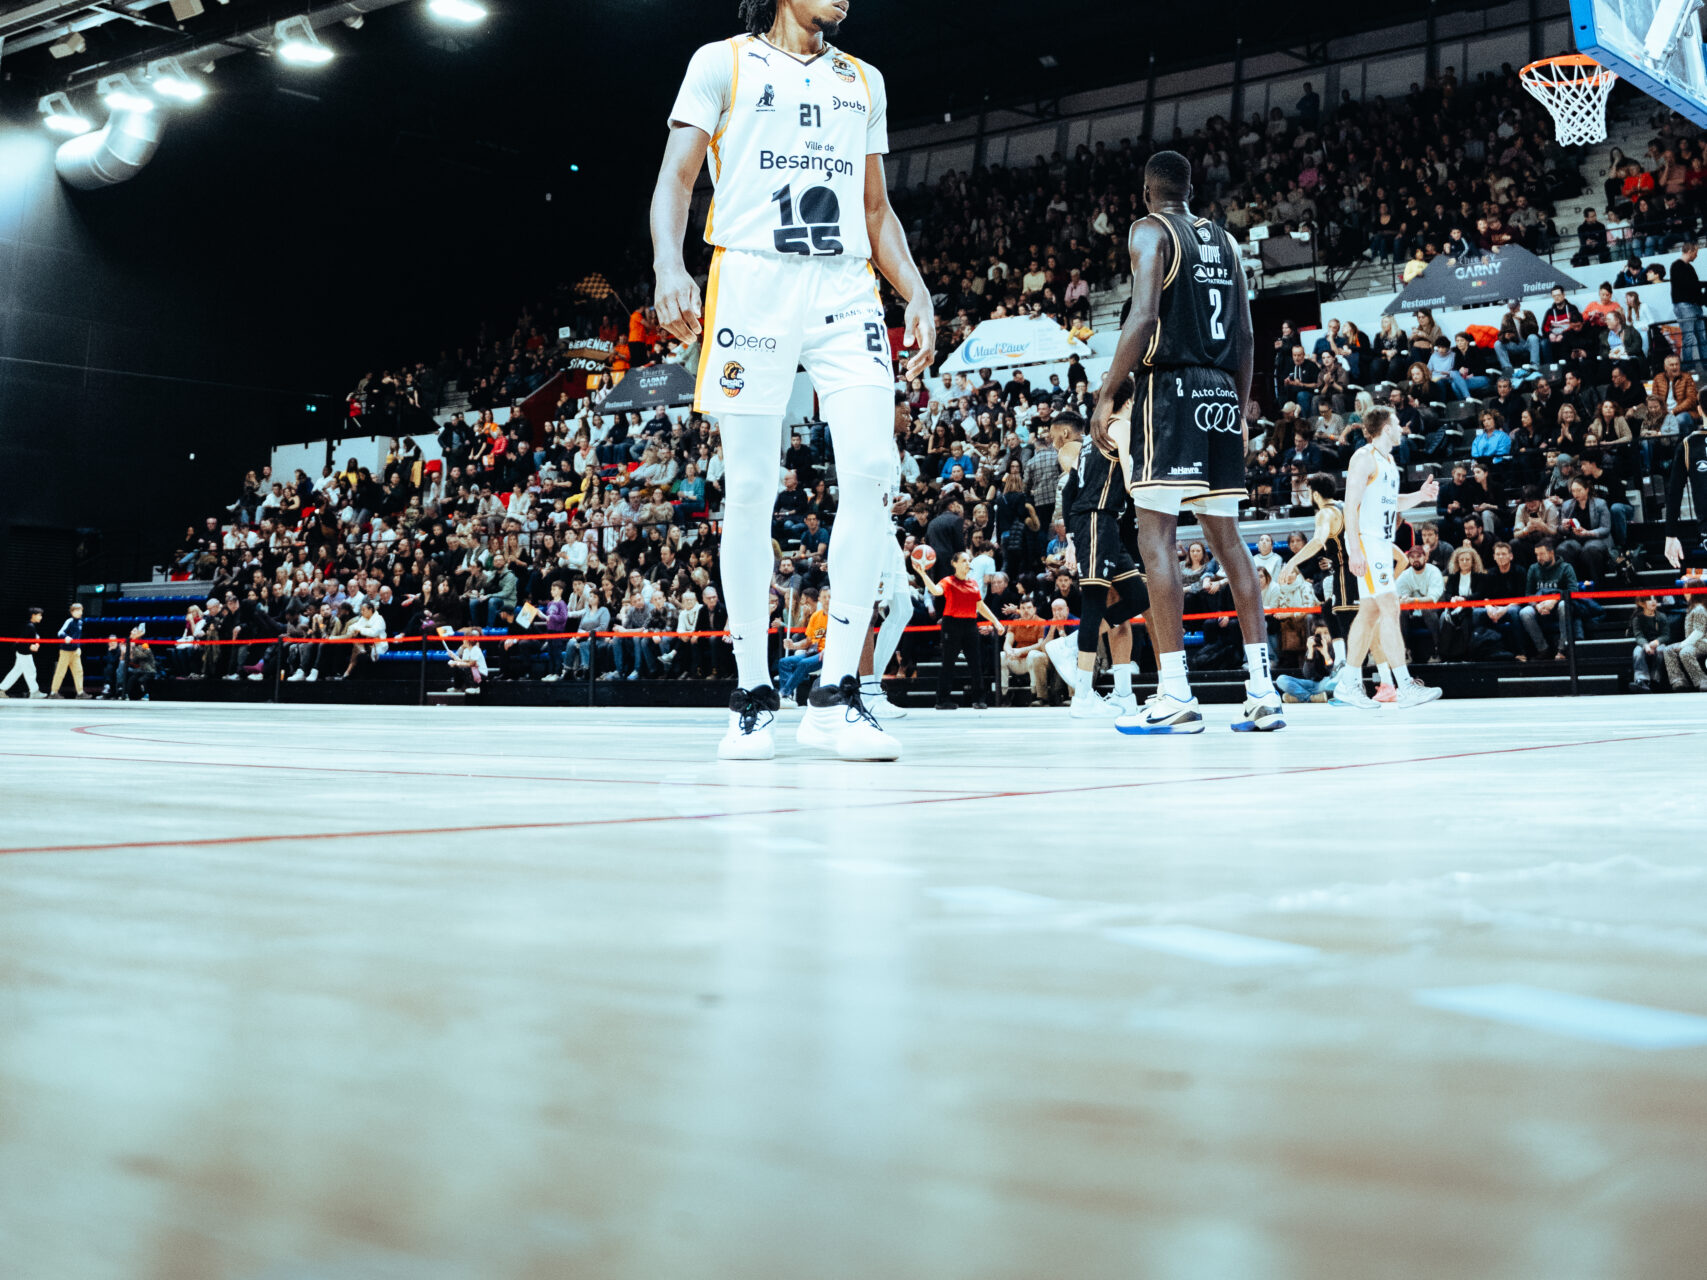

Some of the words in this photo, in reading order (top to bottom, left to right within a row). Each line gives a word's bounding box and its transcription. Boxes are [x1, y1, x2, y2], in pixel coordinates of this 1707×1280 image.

[800, 103, 821, 128] 21
[805, 141, 823, 151] Ville
[824, 143, 835, 152] de
[760, 150, 853, 182] Besançon
[1454, 261, 1502, 279] GARNY
[1401, 295, 1446, 308] Restaurant
[1209, 288, 1226, 340] 2
[717, 327, 777, 349] Opera
[864, 322, 890, 356] 21
[1175, 377, 1184, 397] 2
[1191, 388, 1214, 399] Alto
